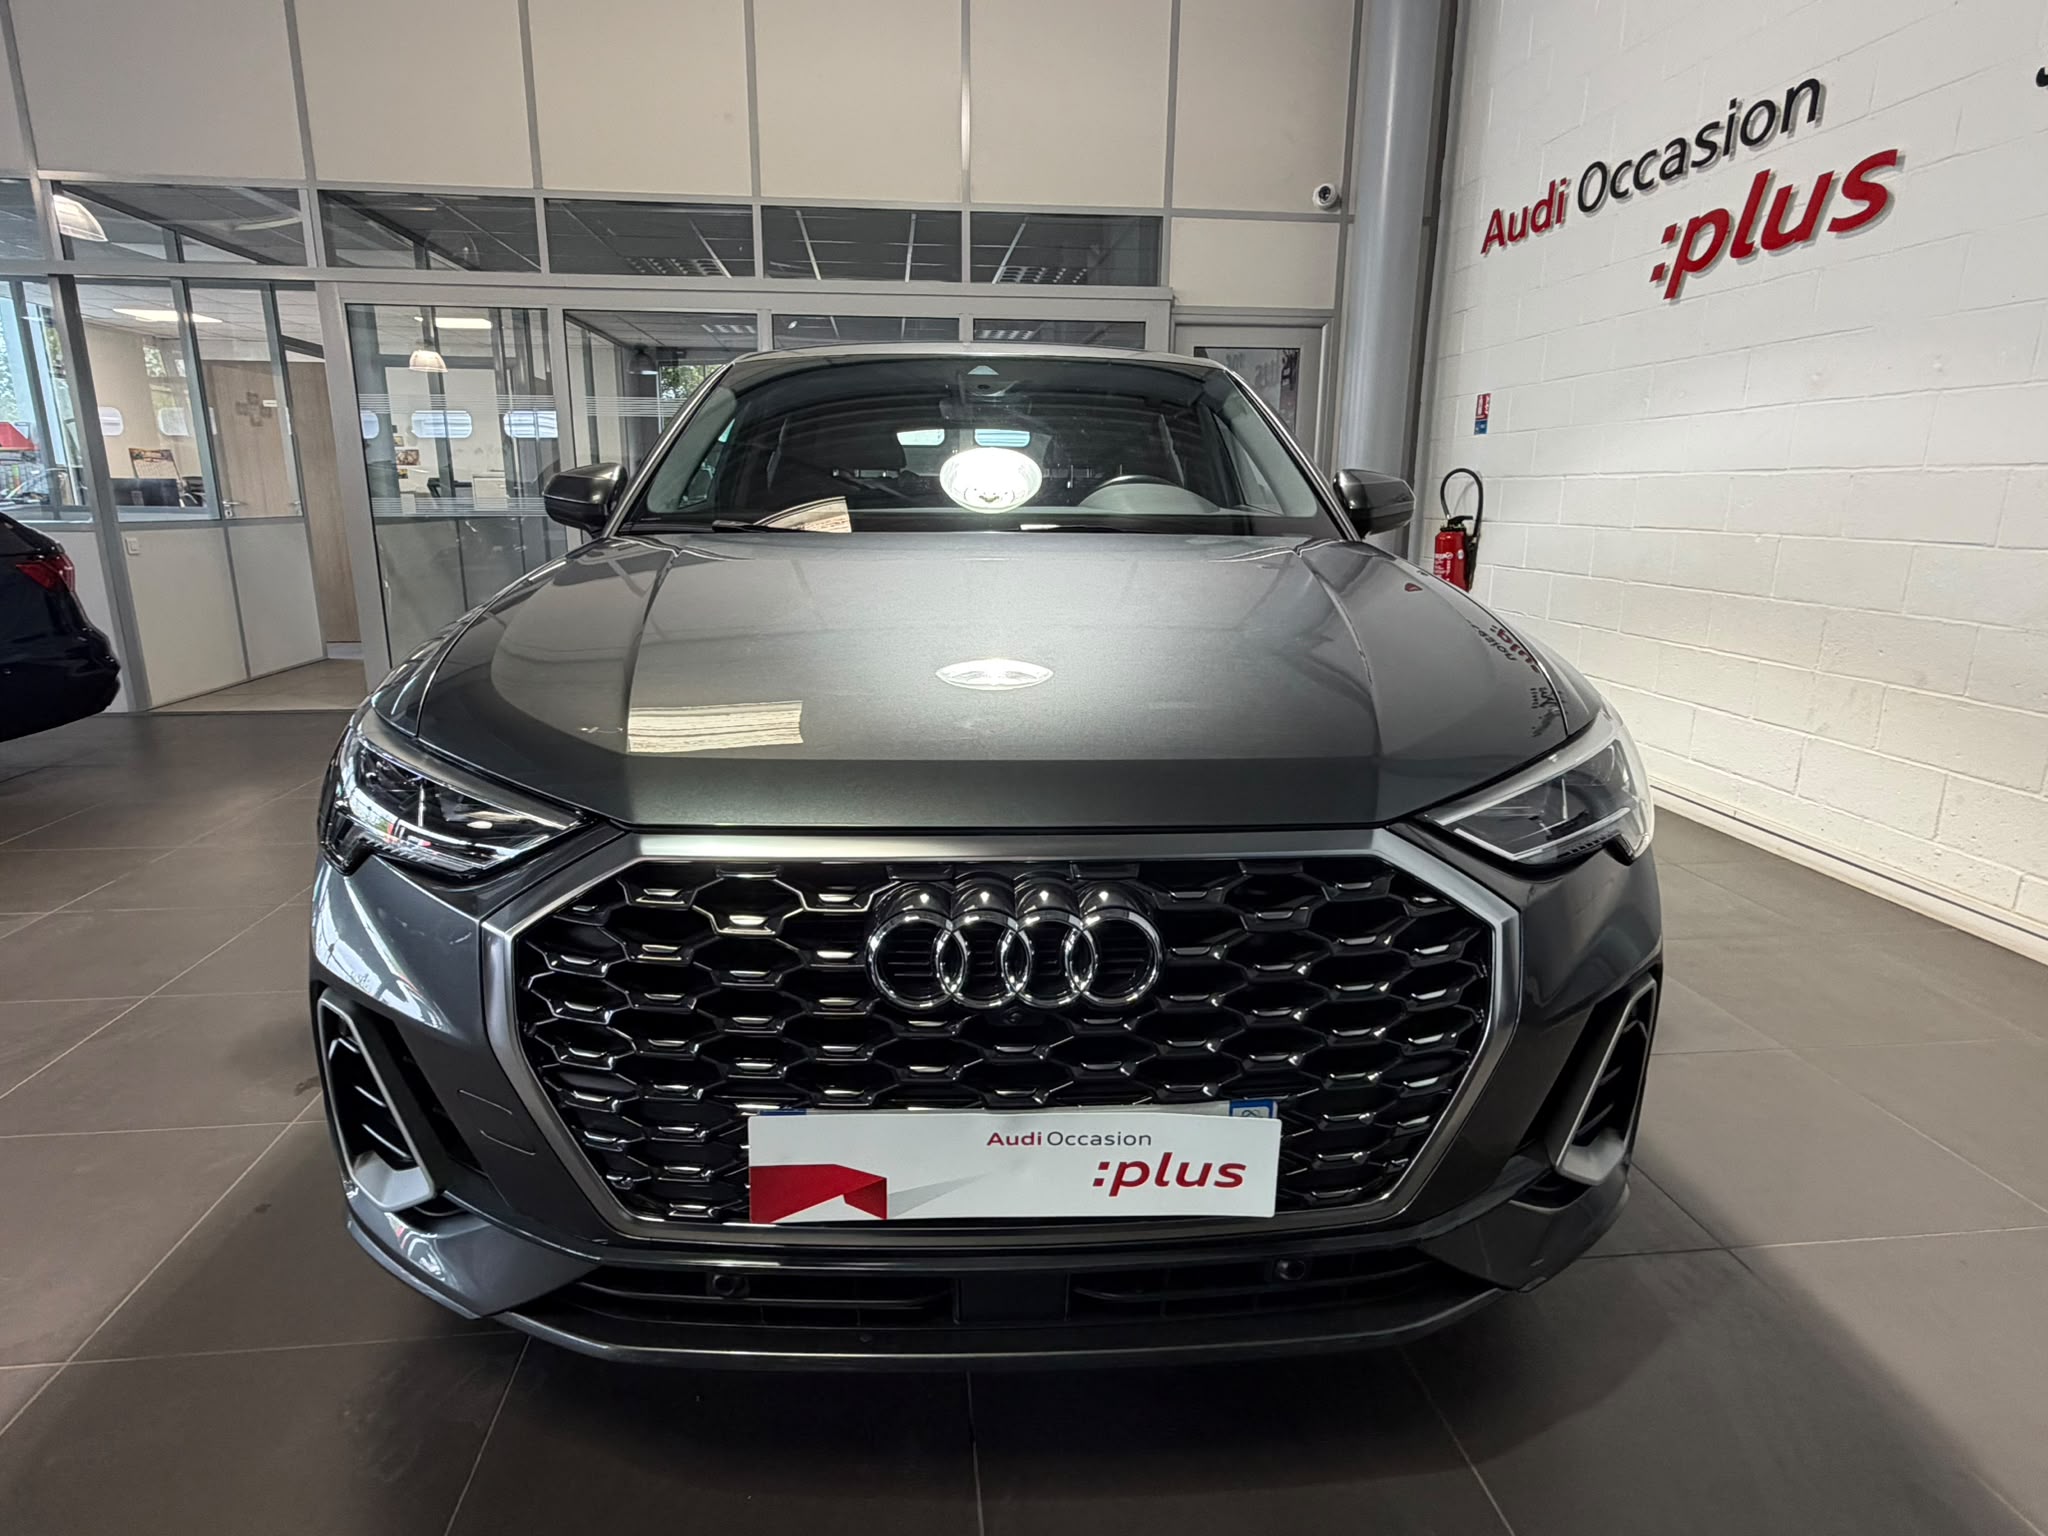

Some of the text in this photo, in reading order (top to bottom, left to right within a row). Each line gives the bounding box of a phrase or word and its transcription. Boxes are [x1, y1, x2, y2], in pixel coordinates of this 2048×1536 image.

[1480, 77, 1822, 255] Audi Occasion
[986, 1130, 1152, 1146] Audi Occasion
